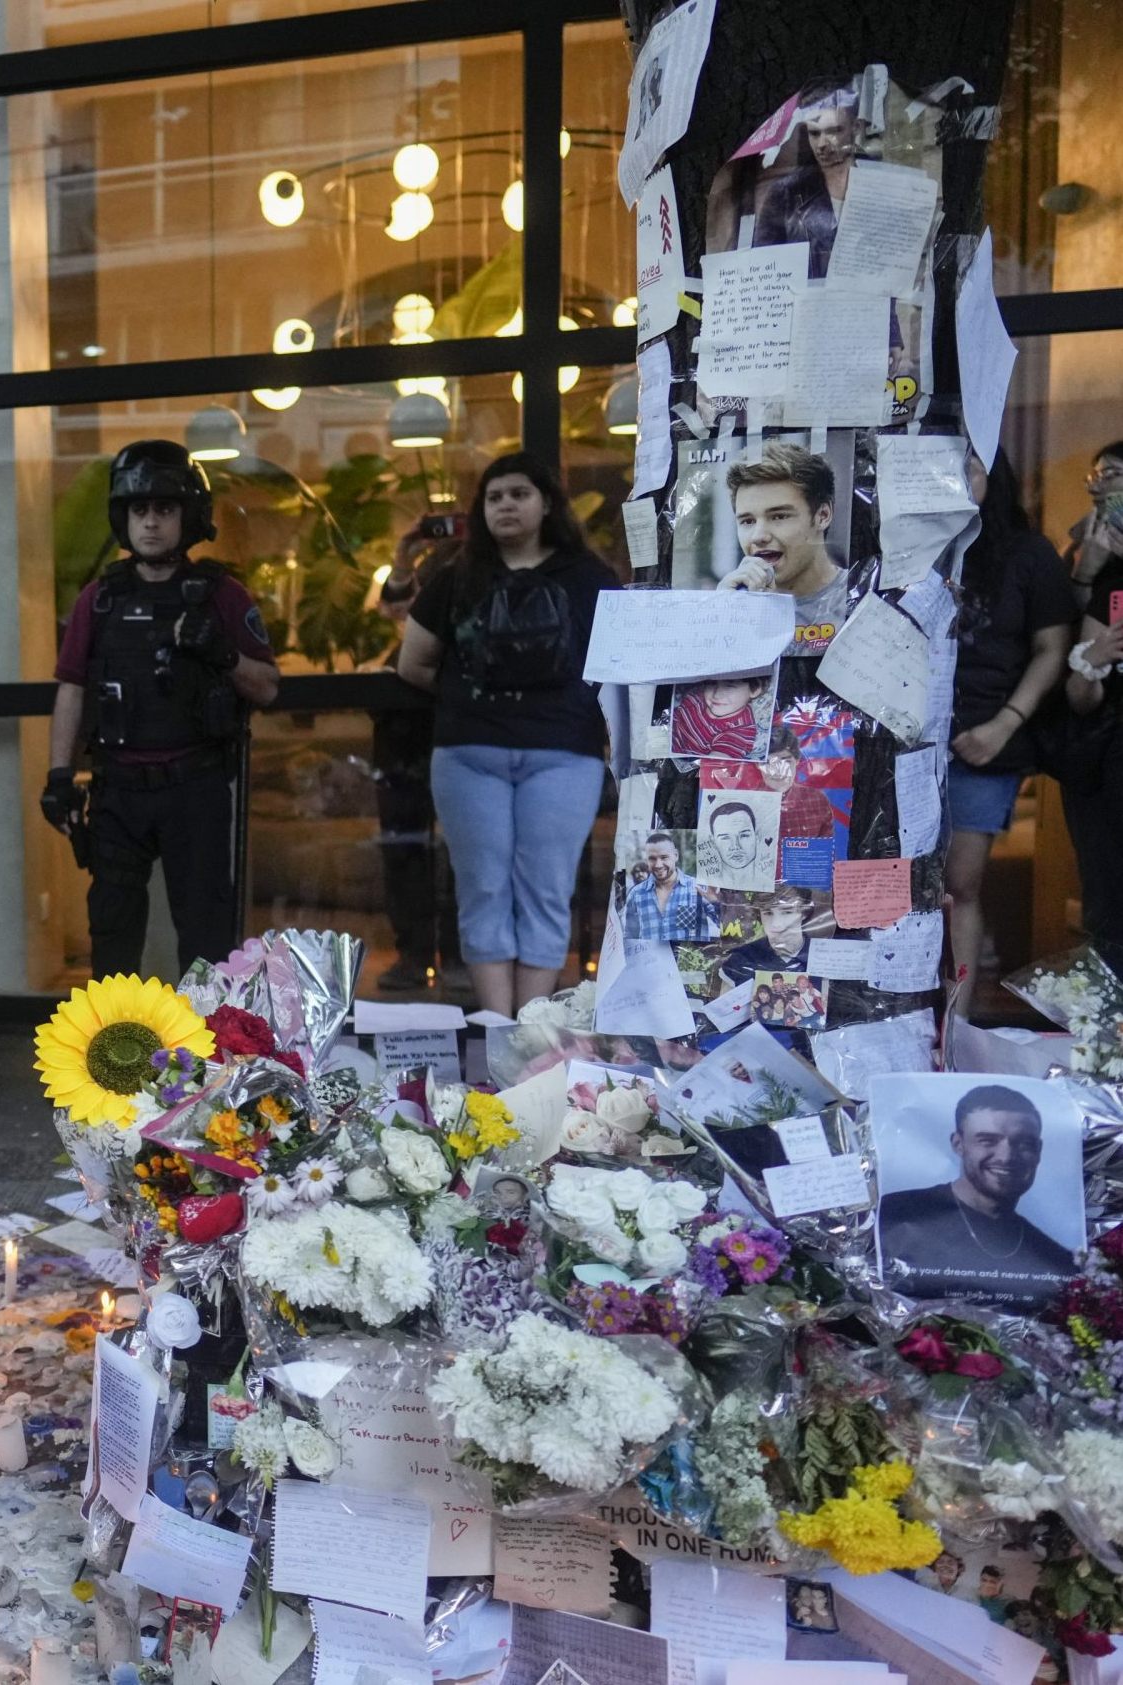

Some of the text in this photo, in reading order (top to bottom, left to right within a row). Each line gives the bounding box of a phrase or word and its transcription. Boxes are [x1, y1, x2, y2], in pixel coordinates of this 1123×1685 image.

[638, 259, 660, 286] oved
[688, 448, 726, 465] LIAM
[920, 1266, 940, 1276] your
[943, 1266, 976, 1277] dream
[979, 1269, 998, 1279] and
[1001, 1271, 1028, 1280] never
[1031, 1272, 1060, 1281] wake
[348, 1427, 373, 1440] Take
[637, 1529, 658, 1548] IN
[665, 1532, 712, 1557] ONE
